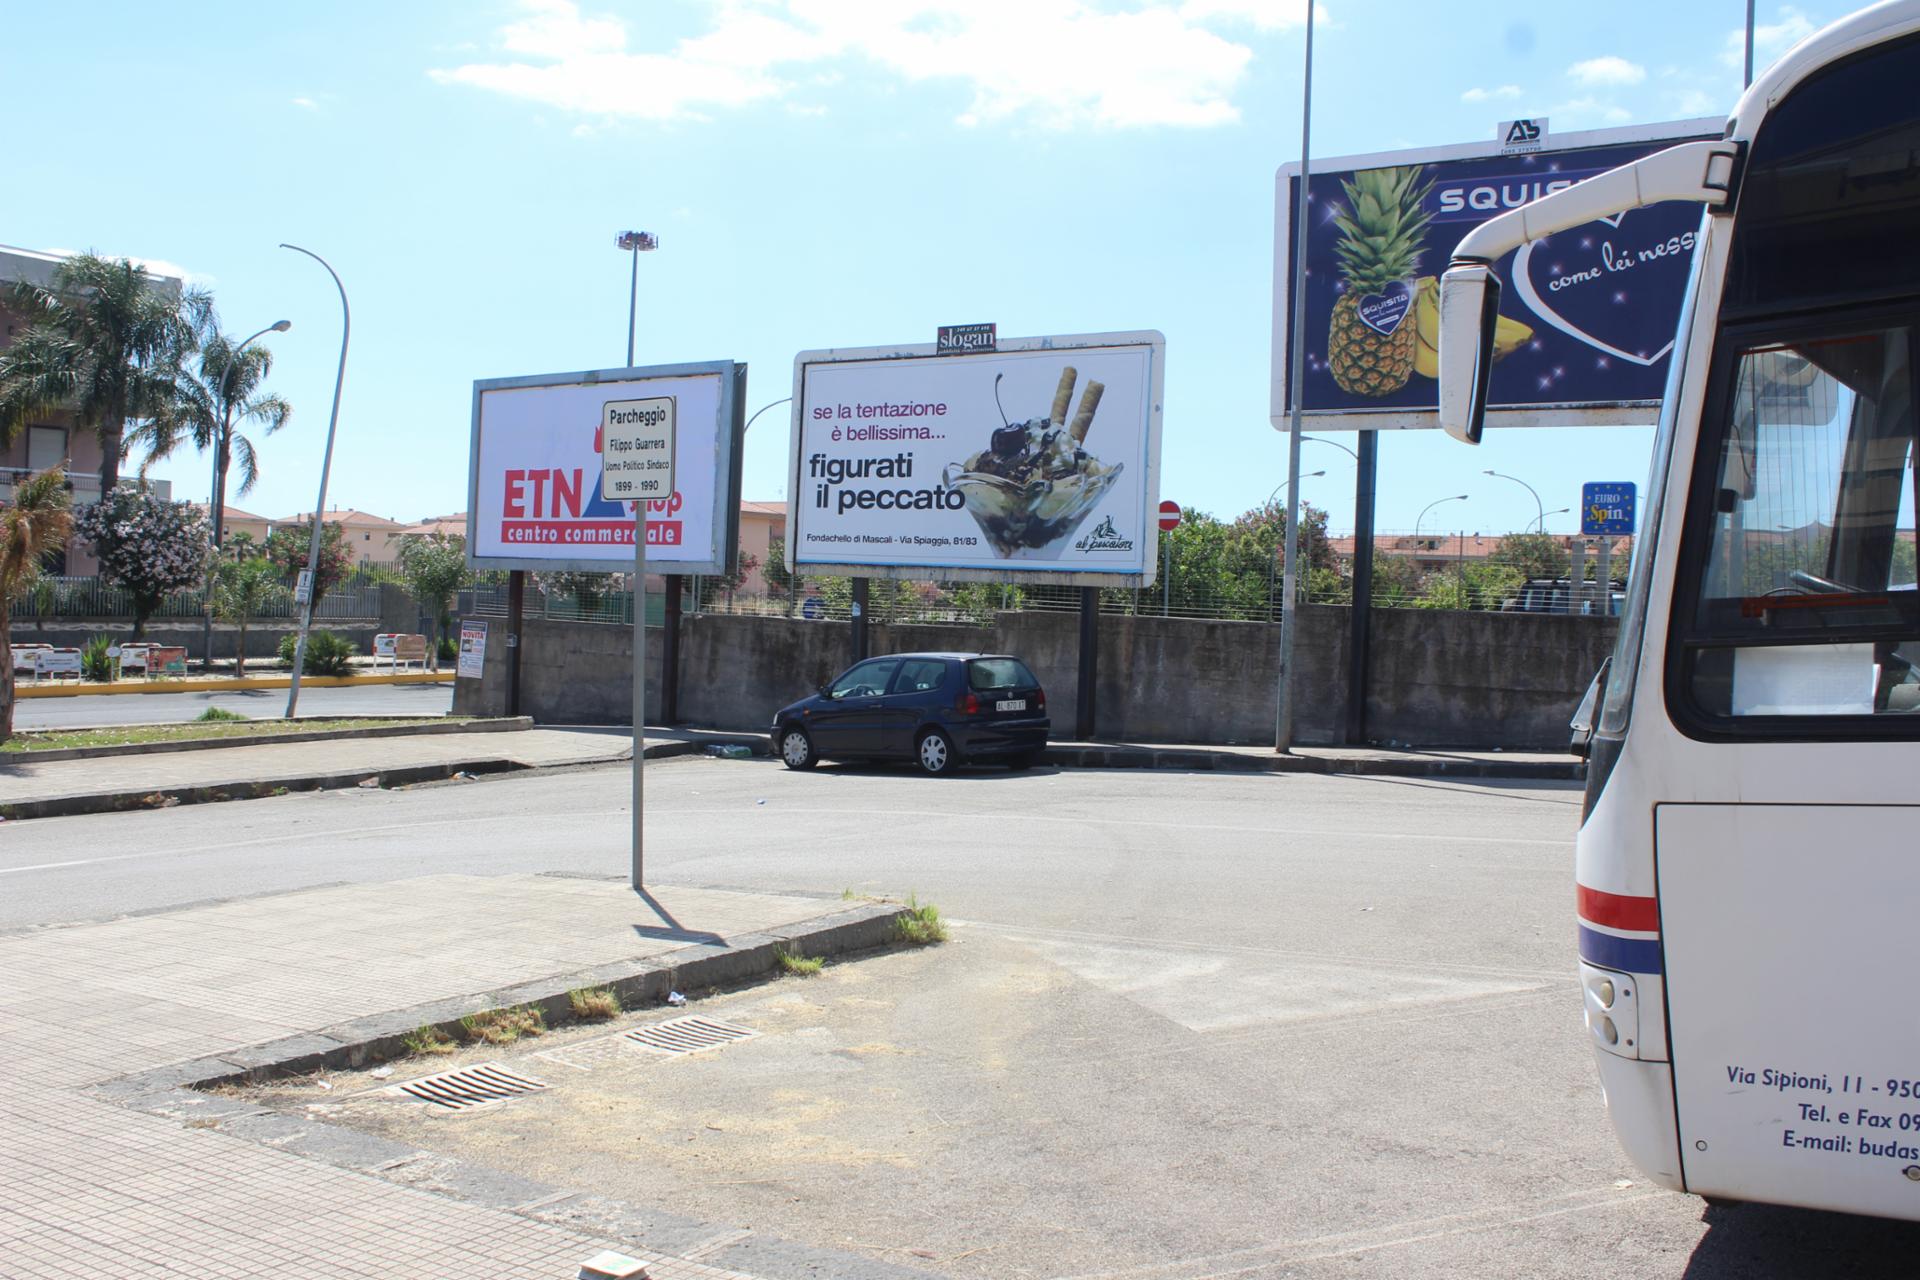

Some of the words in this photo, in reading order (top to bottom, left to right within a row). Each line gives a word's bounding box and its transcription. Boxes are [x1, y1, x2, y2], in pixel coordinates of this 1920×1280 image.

[1549, 267, 1601, 291] come
[1602, 241, 1634, 272] lei
[940, 328, 993, 349] slogan
[610, 406, 666, 426] Parcheggio
[813, 407, 832, 420] se
[837, 403, 851, 419] la
[856, 400, 947, 418] tentazione
[831, 426, 842, 441] è
[847, 424, 945, 441] bellissima...
[610, 439, 632, 453] Filippo
[635, 438, 665, 450] Guarrera
[605, 462, 621, 471] Uomo
[623, 461, 644, 471] Politico
[647, 460, 670, 470] Sindaco
[809, 452, 913, 485] figurati
[615, 481, 632, 491] 1899
[641, 480, 659, 490] 1990
[816, 484, 829, 508] il
[838, 485, 966, 515] peccato
[1594, 494, 1620, 503] EURO
[1590, 505, 1624, 524] Spin
[507, 526, 558, 541] centro
[565, 524, 675, 542] commercale
[807, 533, 852, 543] Fondachello
[853, 534, 861, 544] di
[862, 535, 893, 544] Mascali
[900, 536, 912, 544] Via
[953, 537, 978, 546] 81/83
[1727, 1066, 1756, 1084] Via
[1762, 1068, 1833, 1094] Sipioni,
[1798, 1103, 1831, 1123] Tel.
[1838, 1112, 1850, 1125] e
[1857, 1108, 1893, 1129] Fax
[1783, 1129, 1852, 1153] E-mail:
